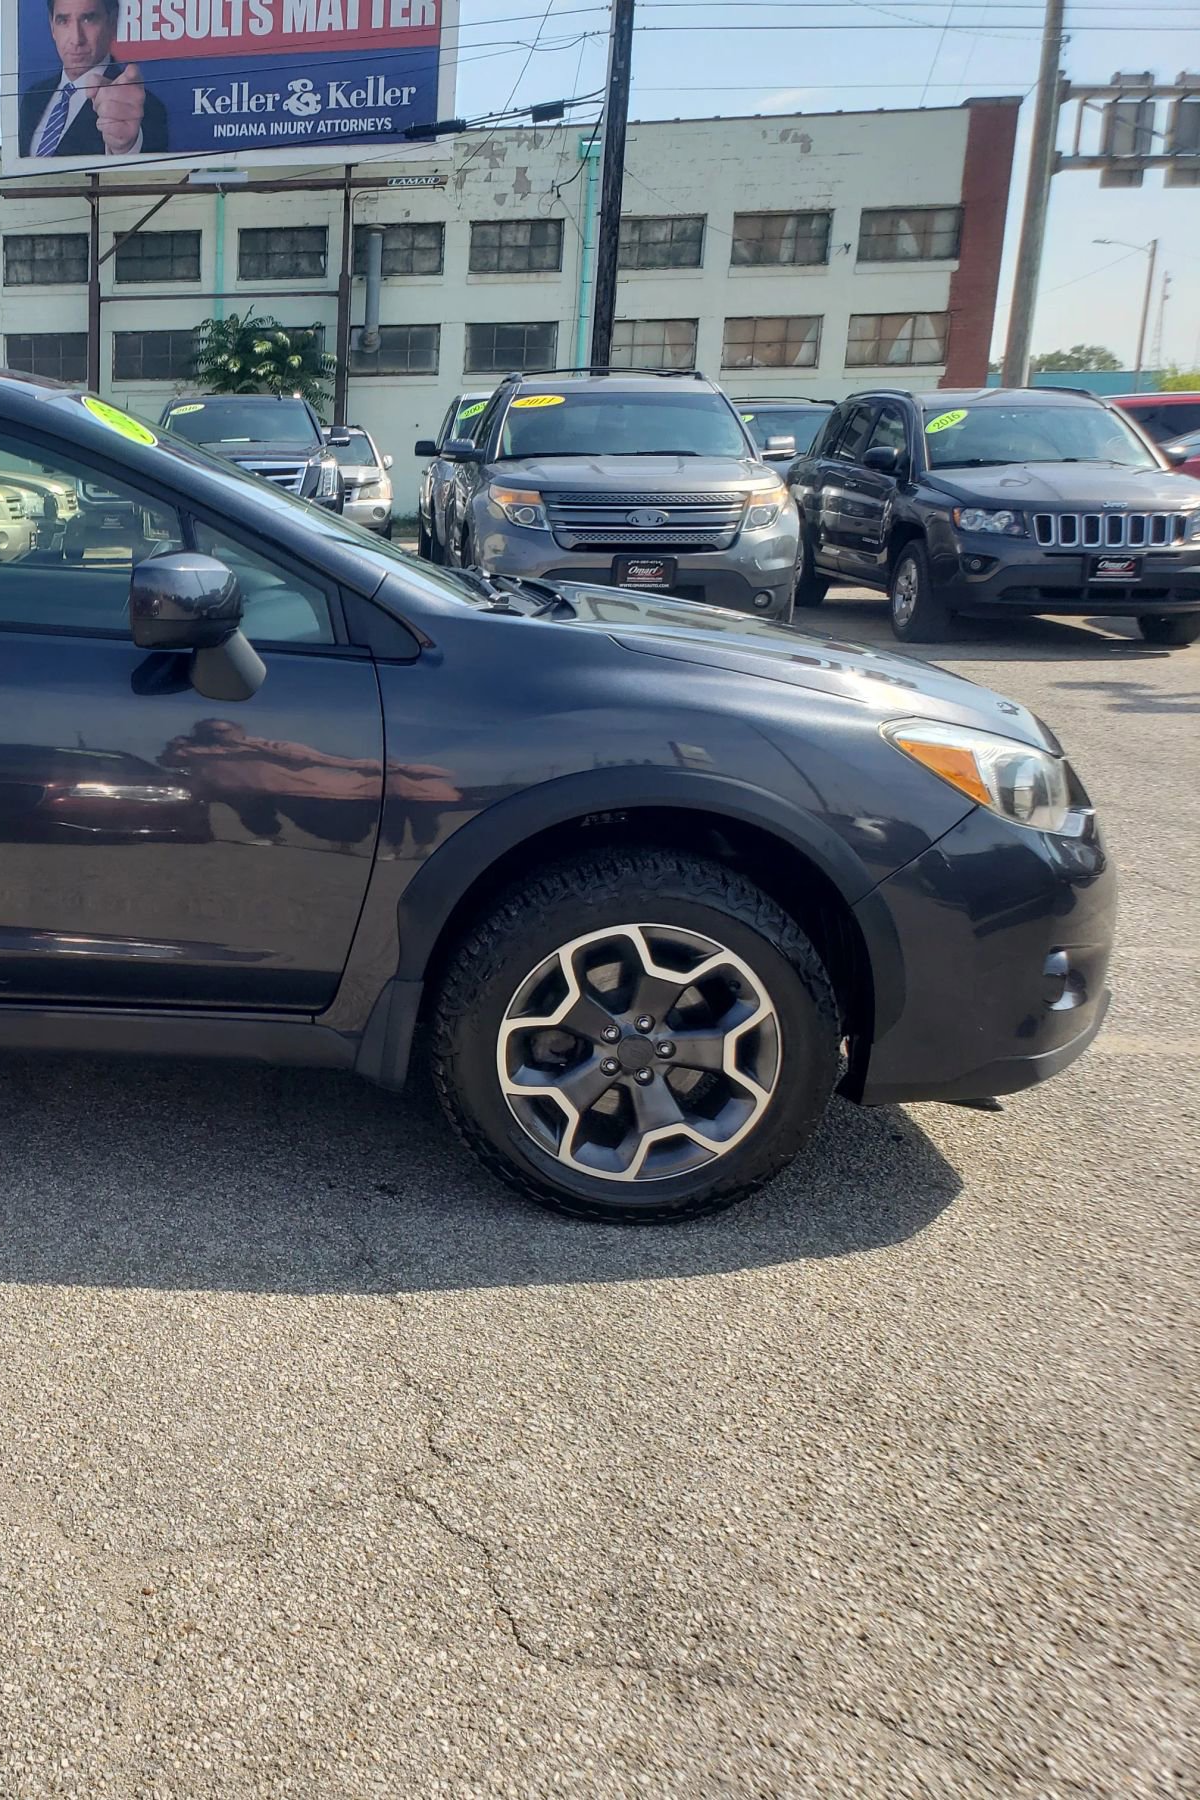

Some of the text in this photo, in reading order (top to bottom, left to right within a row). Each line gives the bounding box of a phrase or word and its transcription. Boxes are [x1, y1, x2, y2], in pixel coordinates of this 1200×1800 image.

[116, 0, 436, 42] RESULTS MATTER
[191, 74, 417, 116] Keller & Keller
[213, 117, 392, 138] INDIANA INJURY ATTORNEYS
[391, 177, 436, 185] LAMAR
[519, 397, 556, 406] 2011
[932, 412, 961, 430] 2016
